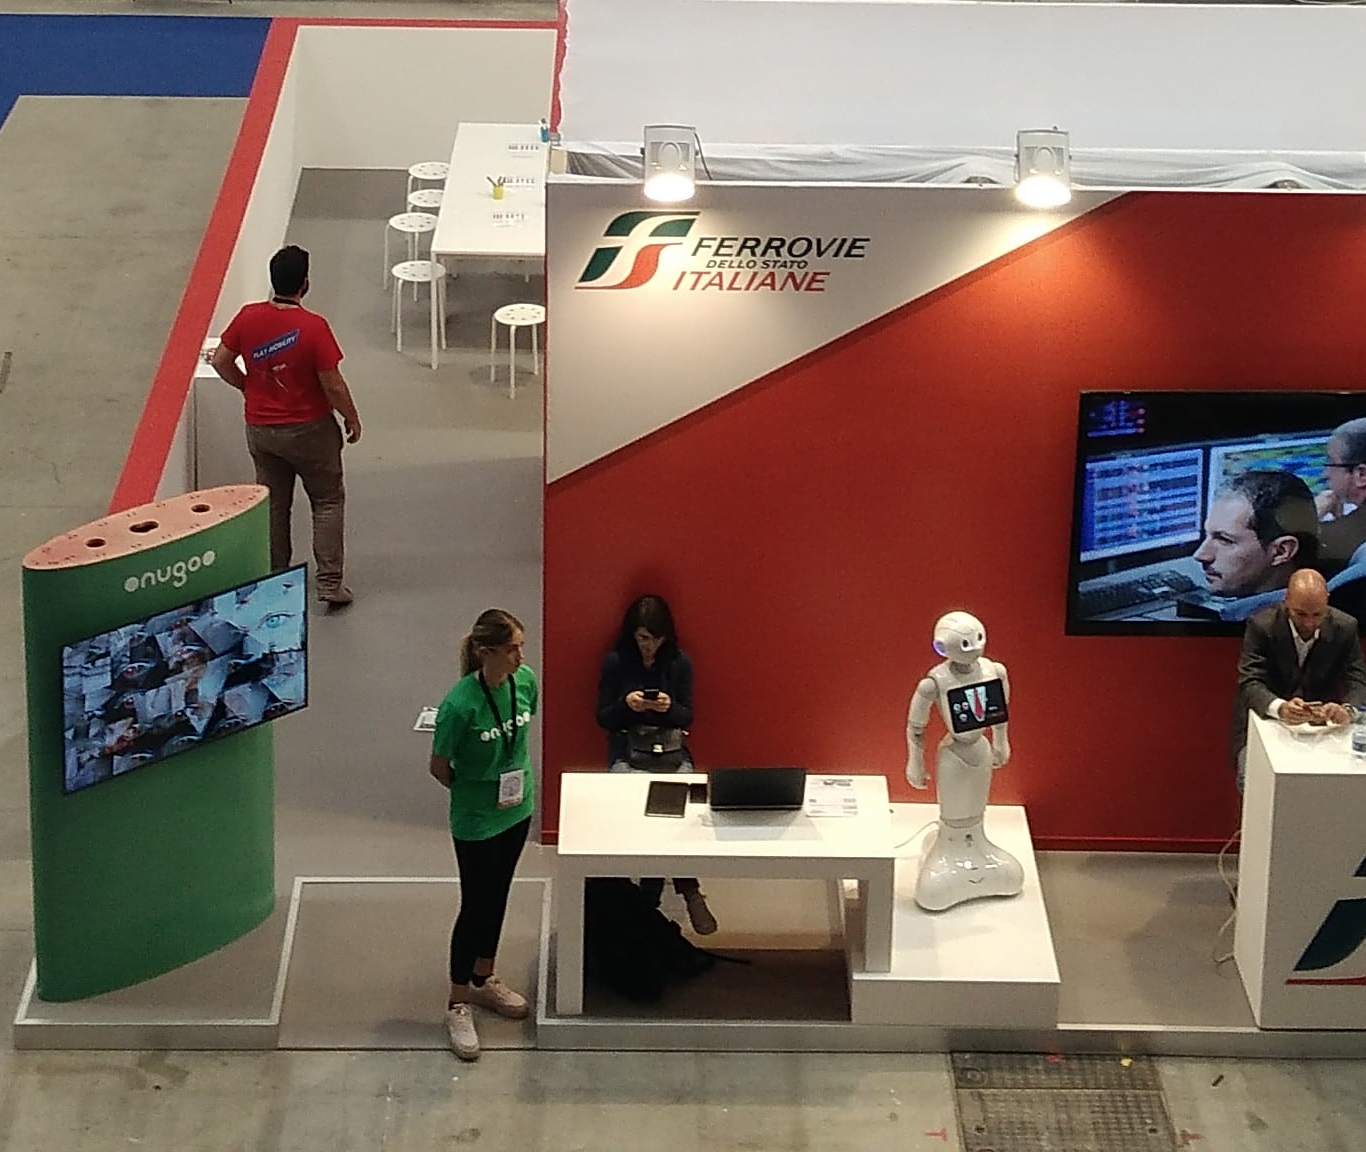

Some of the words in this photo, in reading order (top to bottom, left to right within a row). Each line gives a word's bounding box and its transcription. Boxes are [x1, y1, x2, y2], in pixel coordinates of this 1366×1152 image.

[691, 237, 871, 259] FERROVIE
[705, 259, 757, 269] DELLO
[760, 259, 809, 269] STATO
[672, 271, 831, 292] ITALIANE
[253, 348, 268, 359] PLAY
[268, 335, 296, 353] MOBILITY
